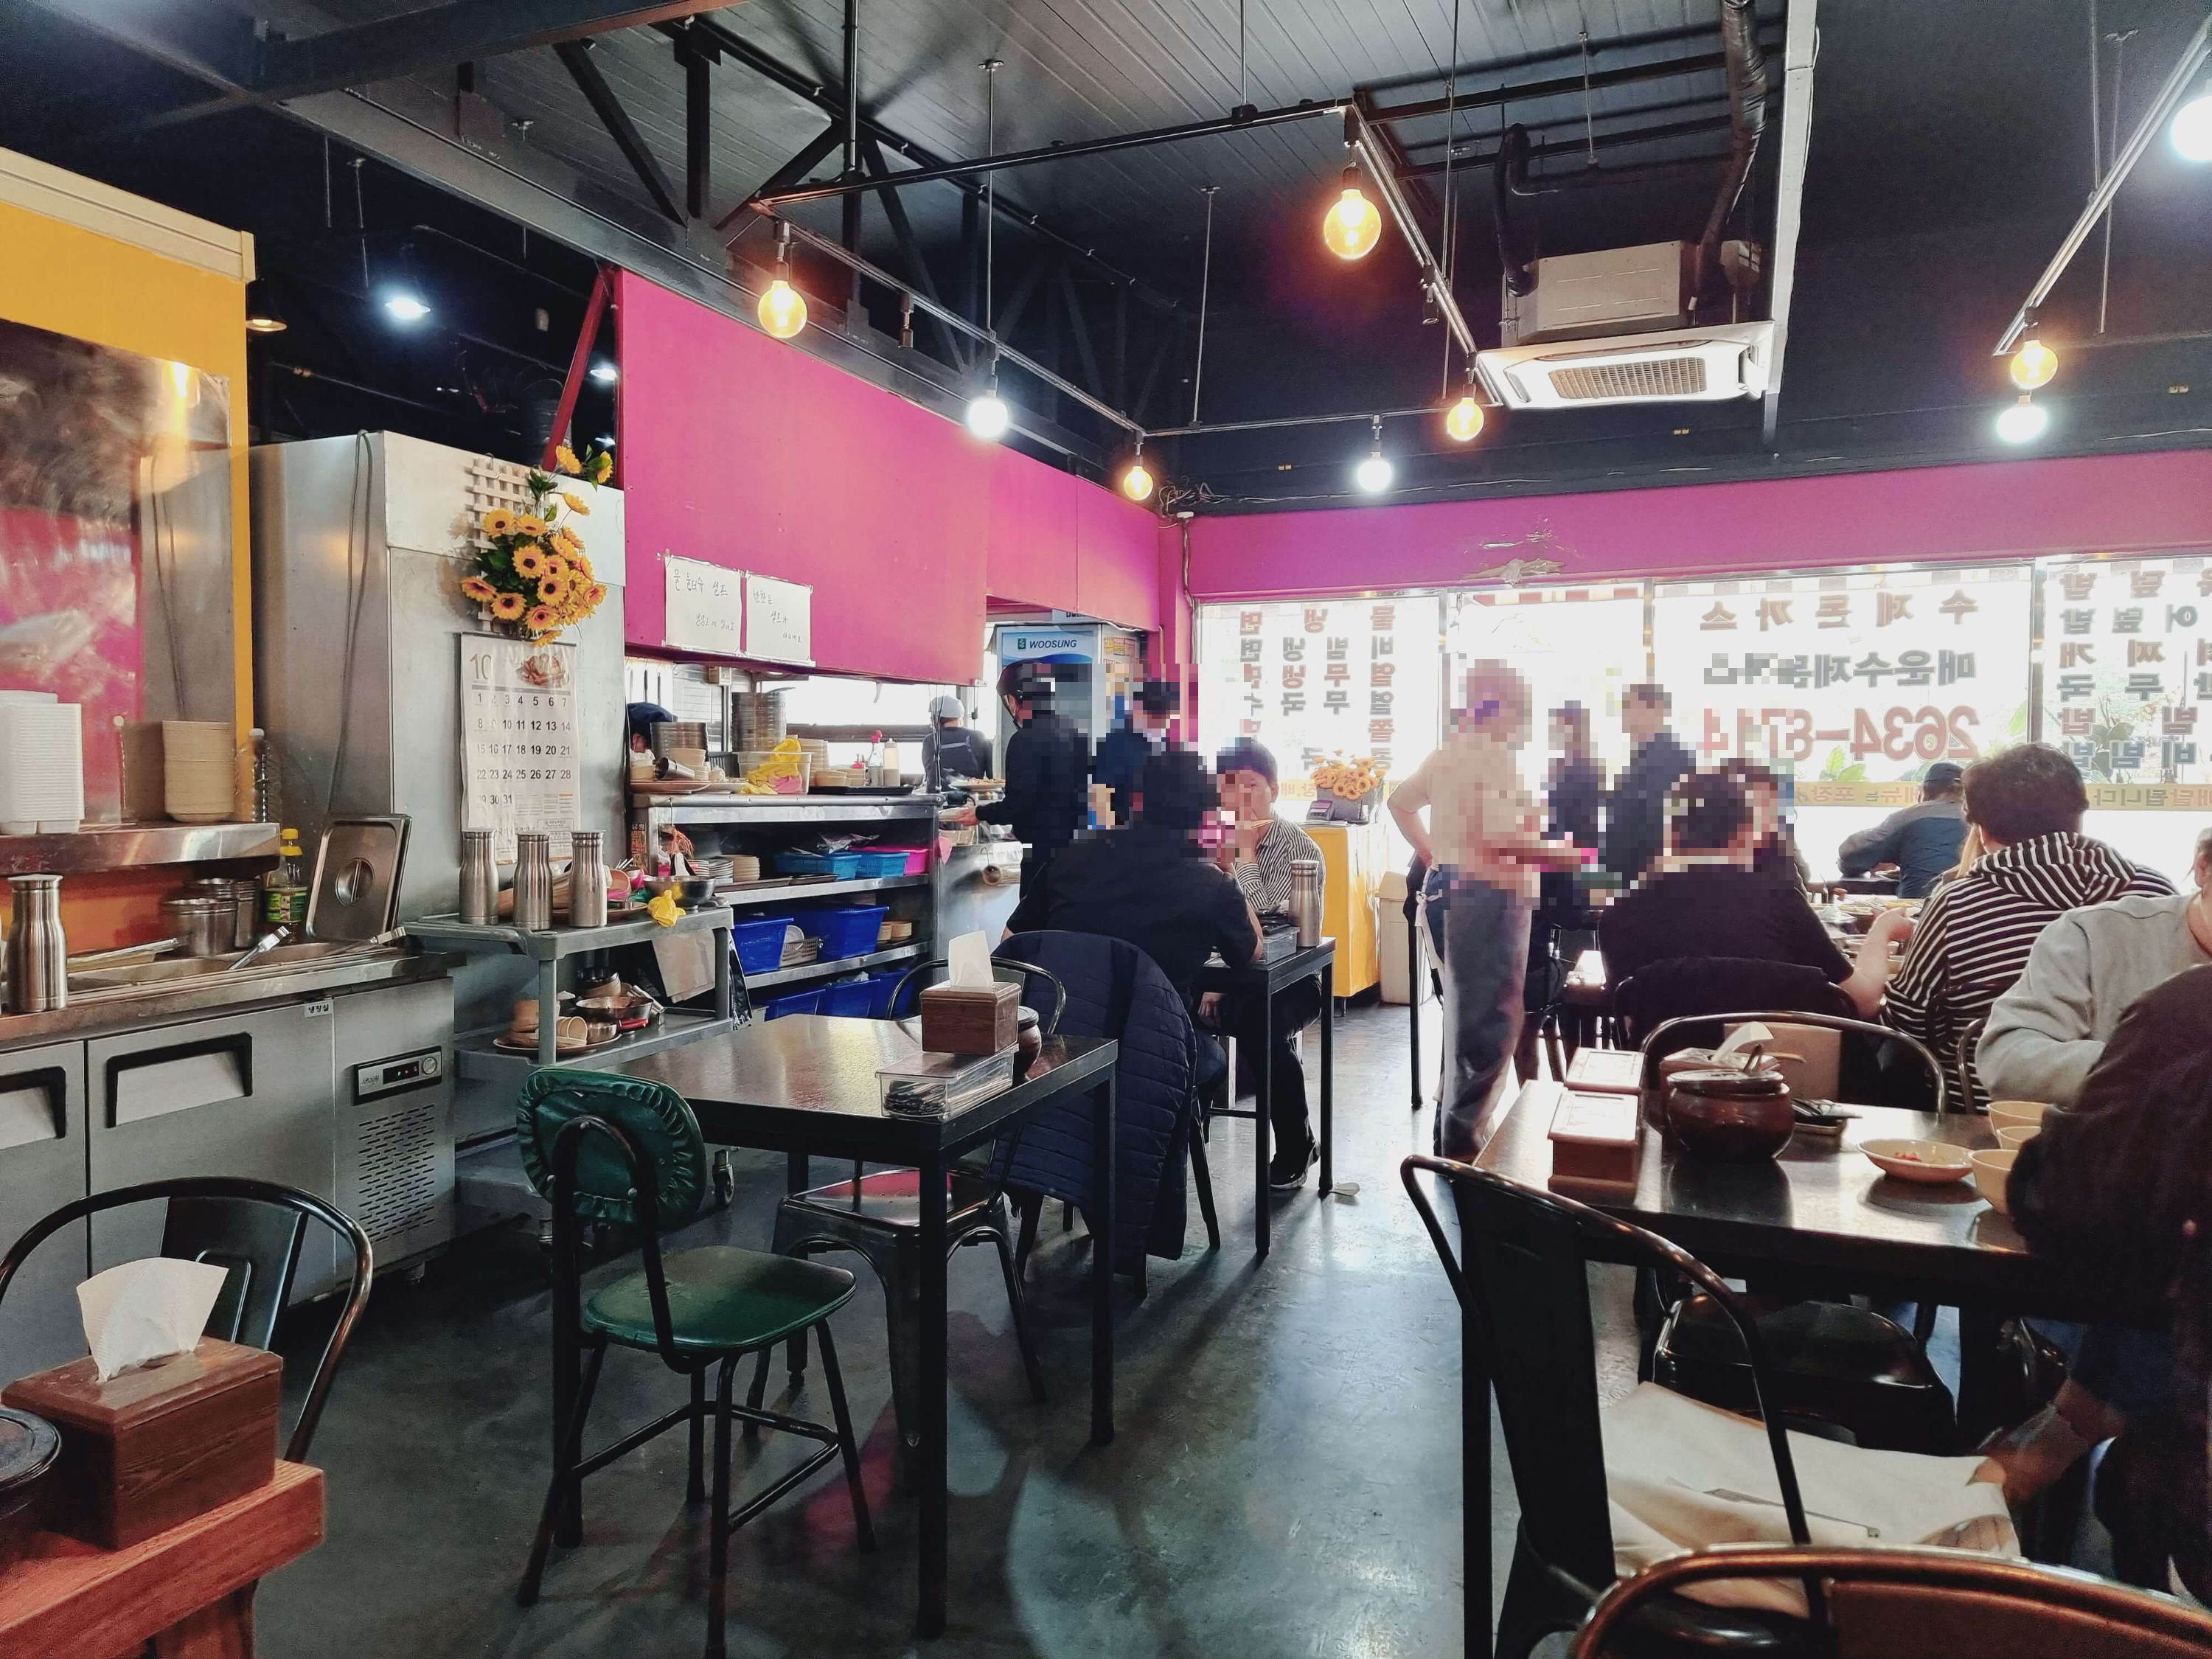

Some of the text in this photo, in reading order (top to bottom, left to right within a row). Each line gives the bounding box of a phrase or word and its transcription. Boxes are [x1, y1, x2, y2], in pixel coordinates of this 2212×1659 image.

[712, 580, 728, 596] 셀프
[1030, 639, 1077, 649] WOOSUNG
[470, 653, 492, 681] 10
[478, 693, 481, 703] 1
[505, 695, 509, 704] 3
[518, 695, 524, 705] 4
[533, 696, 538, 706] 5
[549, 697, 554, 706] 6
[562, 698, 566, 707] 7
[478, 718, 482, 728] 8
[503, 720, 512, 729] 10
[517, 721, 525, 730] 11
[531, 721, 541, 730] 12
[546, 721, 556, 731] 13
[561, 722, 570, 731] 14
[490, 745, 498, 754] 16
[503, 745, 512, 754] 17
[516, 745, 525, 754] 18
[531, 745, 540, 755] 19
[546, 745, 556, 755] 20
[560, 746, 570, 755] 21
[478, 770, 571, 779] 22 23 24 25 26 27 28
[490, 796, 498, 805] 30
[504, 795, 512, 804] 31
